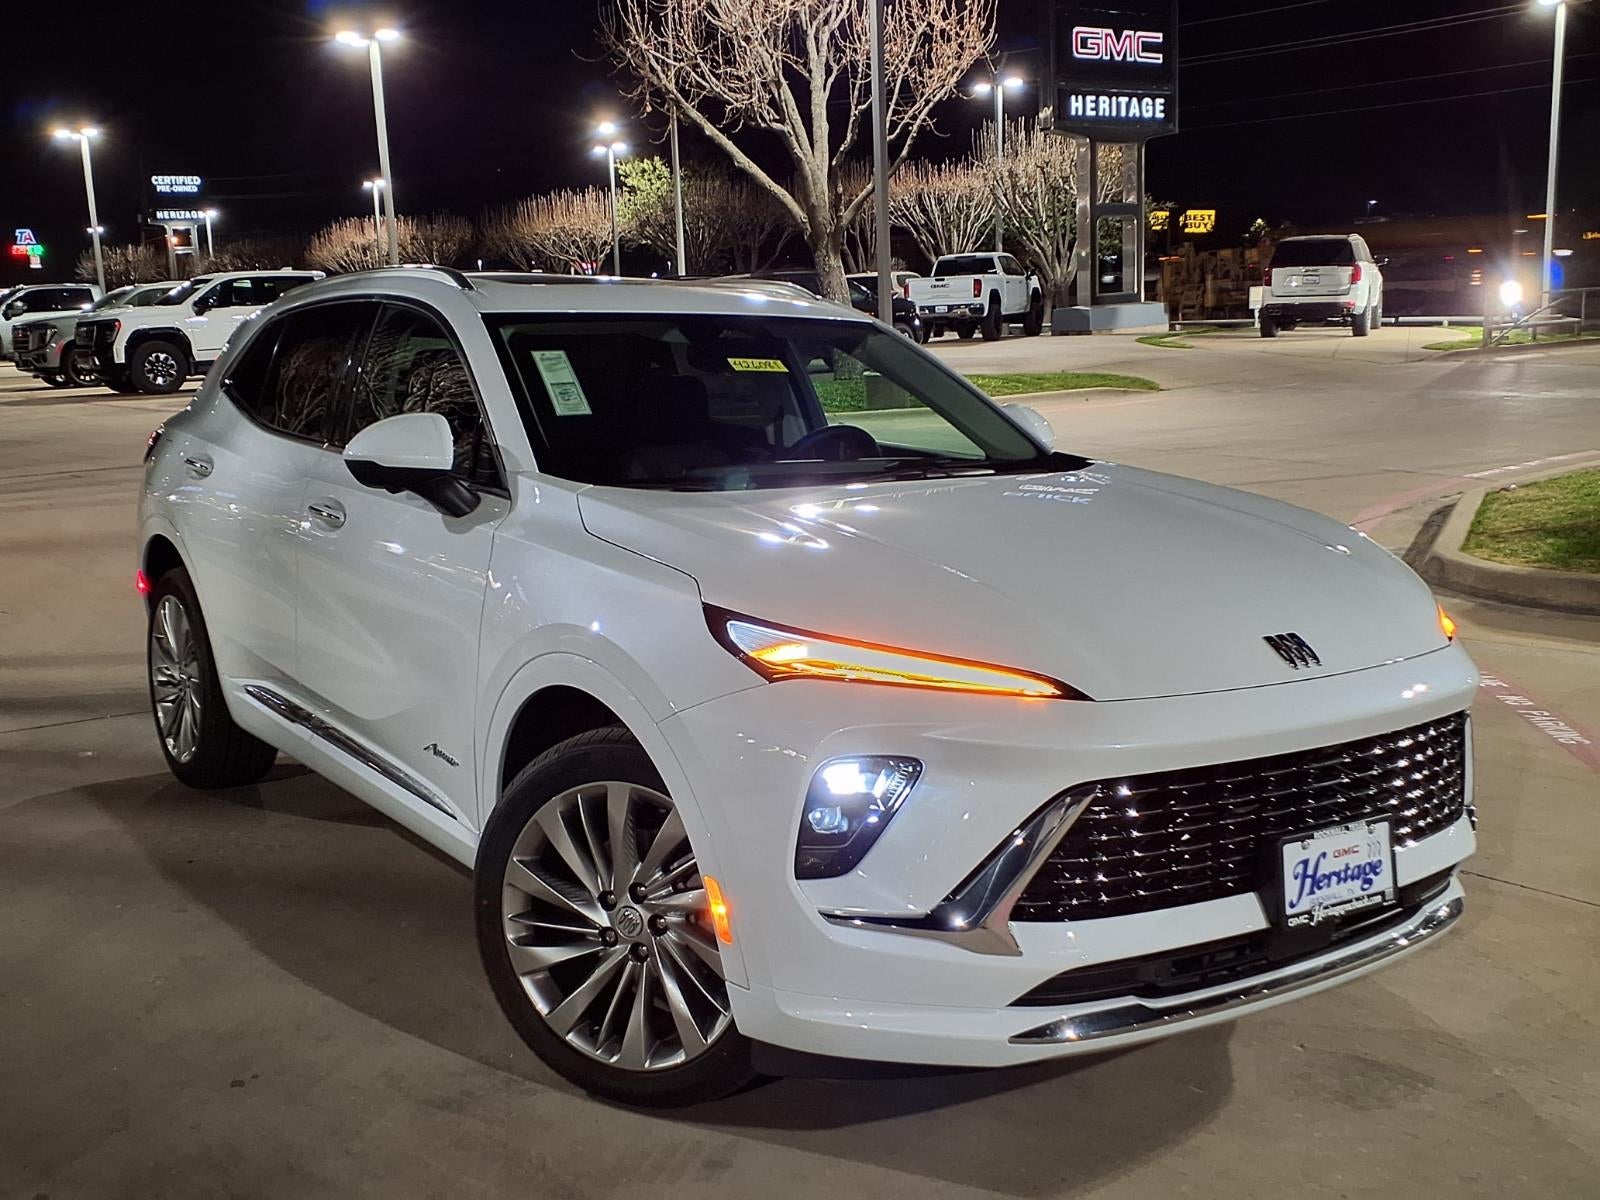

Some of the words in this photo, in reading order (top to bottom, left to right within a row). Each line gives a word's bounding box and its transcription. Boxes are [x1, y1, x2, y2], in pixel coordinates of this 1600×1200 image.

[1072, 26, 1163, 64] GMC
[1070, 94, 1165, 118] HERITAGE
[151, 175, 201, 185] CERTIFIED
[156, 185, 198, 193] PRE-OWNED
[16, 229, 36, 244] TA
[1517, 710, 1592, 744] PARKING
[1333, 845, 1360, 858] GMC
[1288, 851, 1383, 909] Heritage
